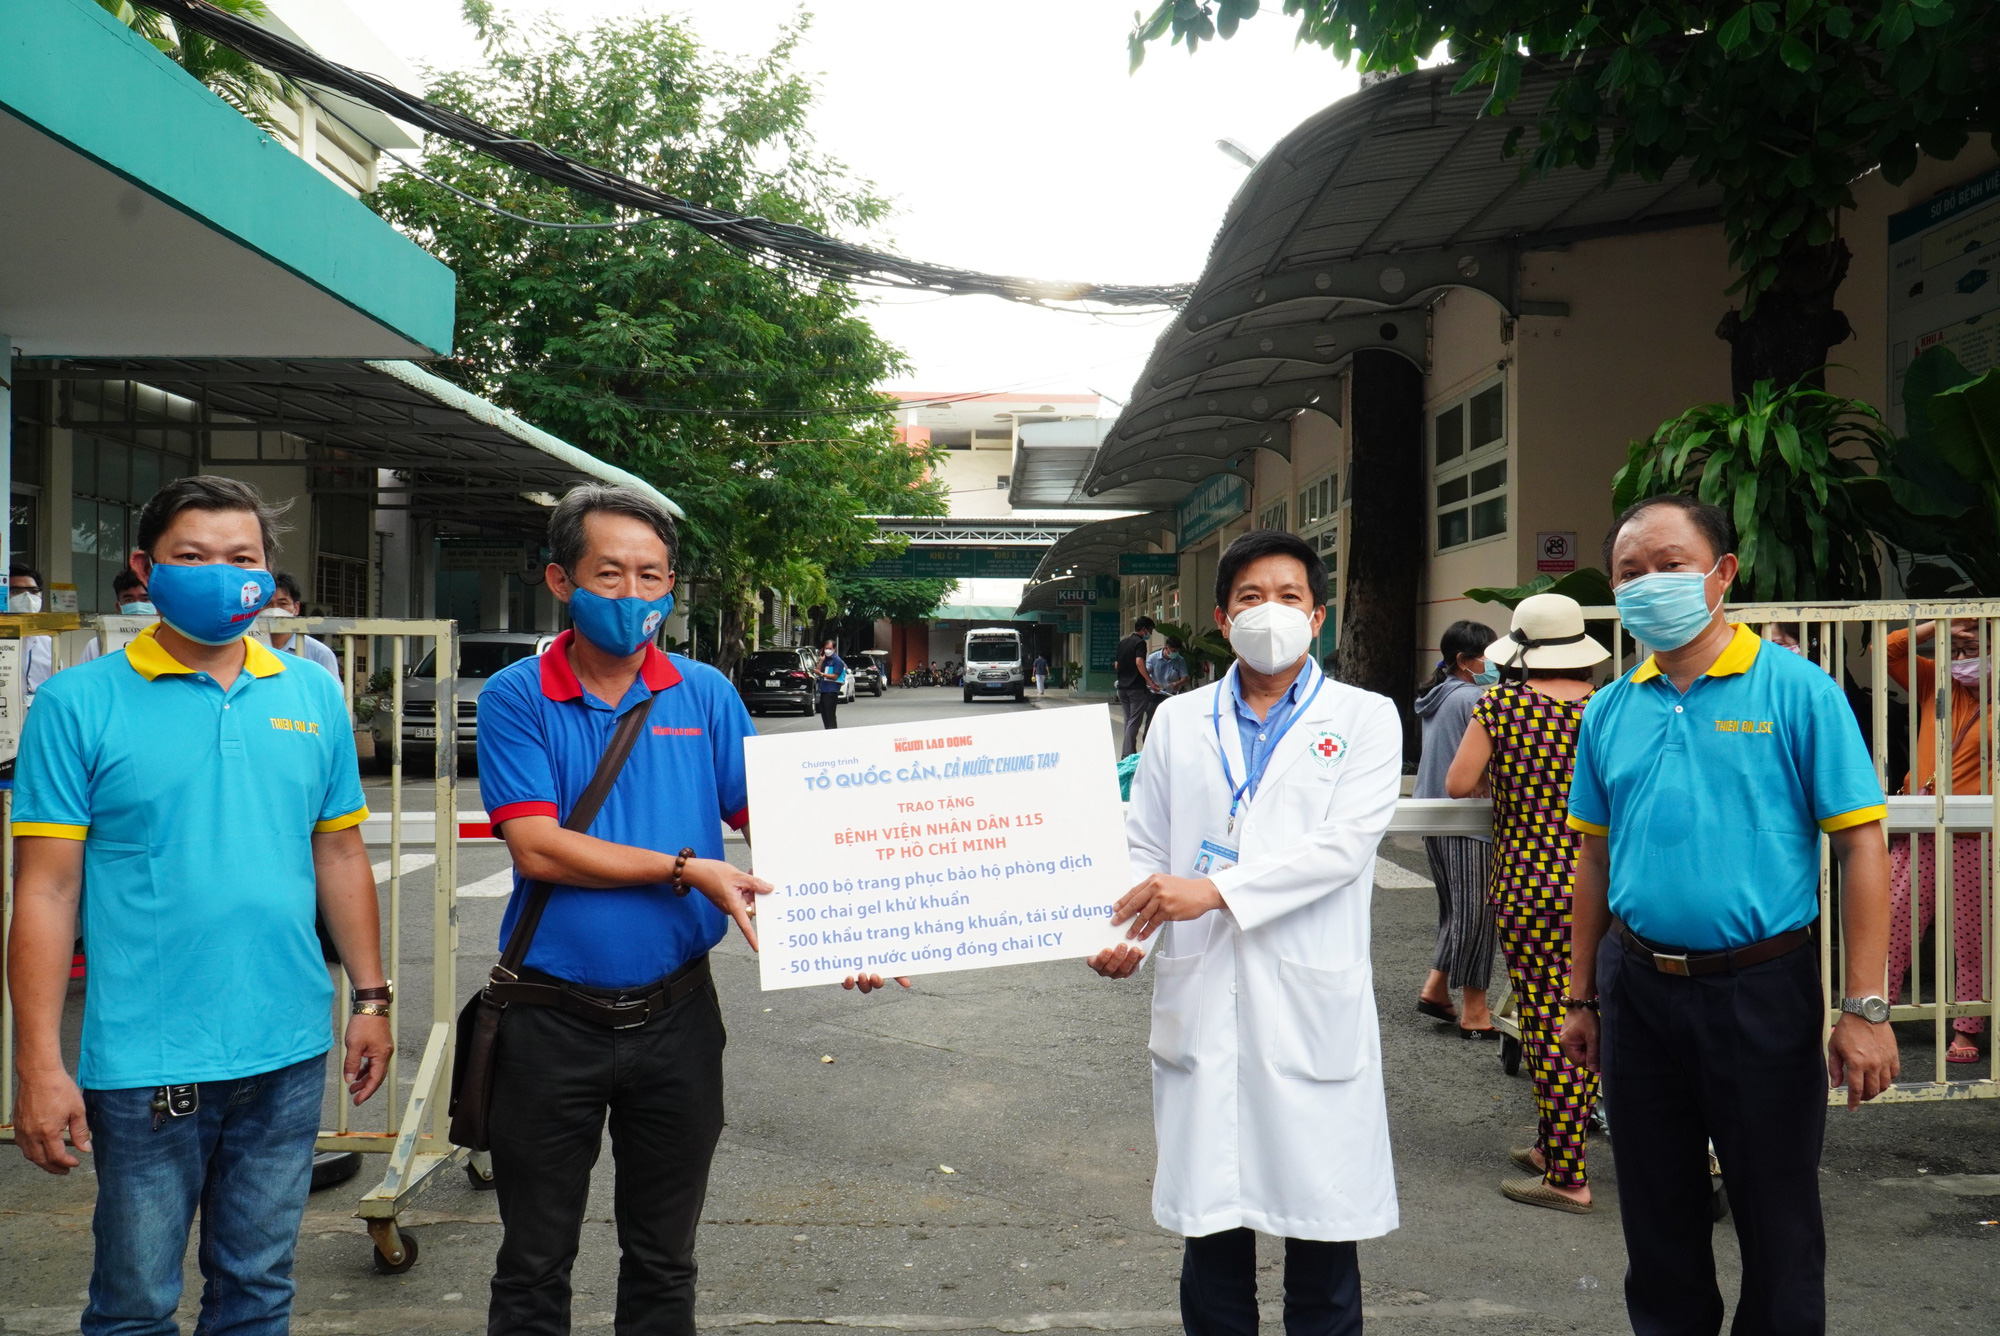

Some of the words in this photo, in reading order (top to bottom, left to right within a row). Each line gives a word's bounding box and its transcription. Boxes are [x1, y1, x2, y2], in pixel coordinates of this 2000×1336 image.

[1921, 333, 1937, 347] KHU
[1058, 591, 1084, 600] KHU
[1088, 591, 1096, 600] B
[1755, 720, 1774, 734] JSC
[926, 738, 945, 750] LAO
[801, 760, 836, 769] Chương
[804, 768, 831, 791] TỔ
[835, 764, 892, 789] QUỐC
[896, 760, 942, 782] CẦN,
[943, 756, 961, 778] CẢ
[961, 754, 994, 777] NƯỚC
[995, 754, 1034, 773] CHUNG
[1037, 752, 1060, 769] TAY
[897, 800, 934, 814] TRAO
[938, 795, 975, 812] TẶNG
[834, 827, 878, 847] BỆNH
[882, 822, 922, 841] VIỆN
[926, 817, 972, 837] NHÂN
[976, 814, 1010, 831] DÂN
[1015, 812, 1044, 827] 115
[876, 847, 896, 861] TP
[928, 837, 958, 856] CHÍ
[962, 836, 1007, 853] MINH
[785, 881, 829, 897] 1.000
[833, 878, 853, 896] bộ
[857, 875, 900, 891] trang
[905, 871, 944, 889] phục
[947, 866, 977, 882] bảo
[981, 863, 1001, 881] hộ
[1005, 859, 1056, 879] phòng
[1059, 854, 1092, 872] dịch
[787, 907, 816, 923] 500
[820, 903, 853, 920] chai
[857, 900, 881, 919] gel
[886, 895, 917, 913] khử
[920, 890, 970, 909] khuẩn
[789, 932, 818, 948] 500
[822, 926, 863, 944] khẩu
[866, 925, 910, 940] trang
[914, 918, 964, 935] kháng
[968, 909, 1023, 930] khuẩn,
[1026, 908, 1047, 923] tái
[1051, 905, 1069, 920] sử
[1072, 904, 1113, 921] dụng
[790, 959, 810, 974] 50
[814, 955, 863, 971] thùng
[867, 949, 907, 965] nước
[911, 944, 952, 962] uống
[956, 940, 998, 957] đóng
[1001, 935, 1034, 951] chai
[1038, 932, 1063, 948] ICY
